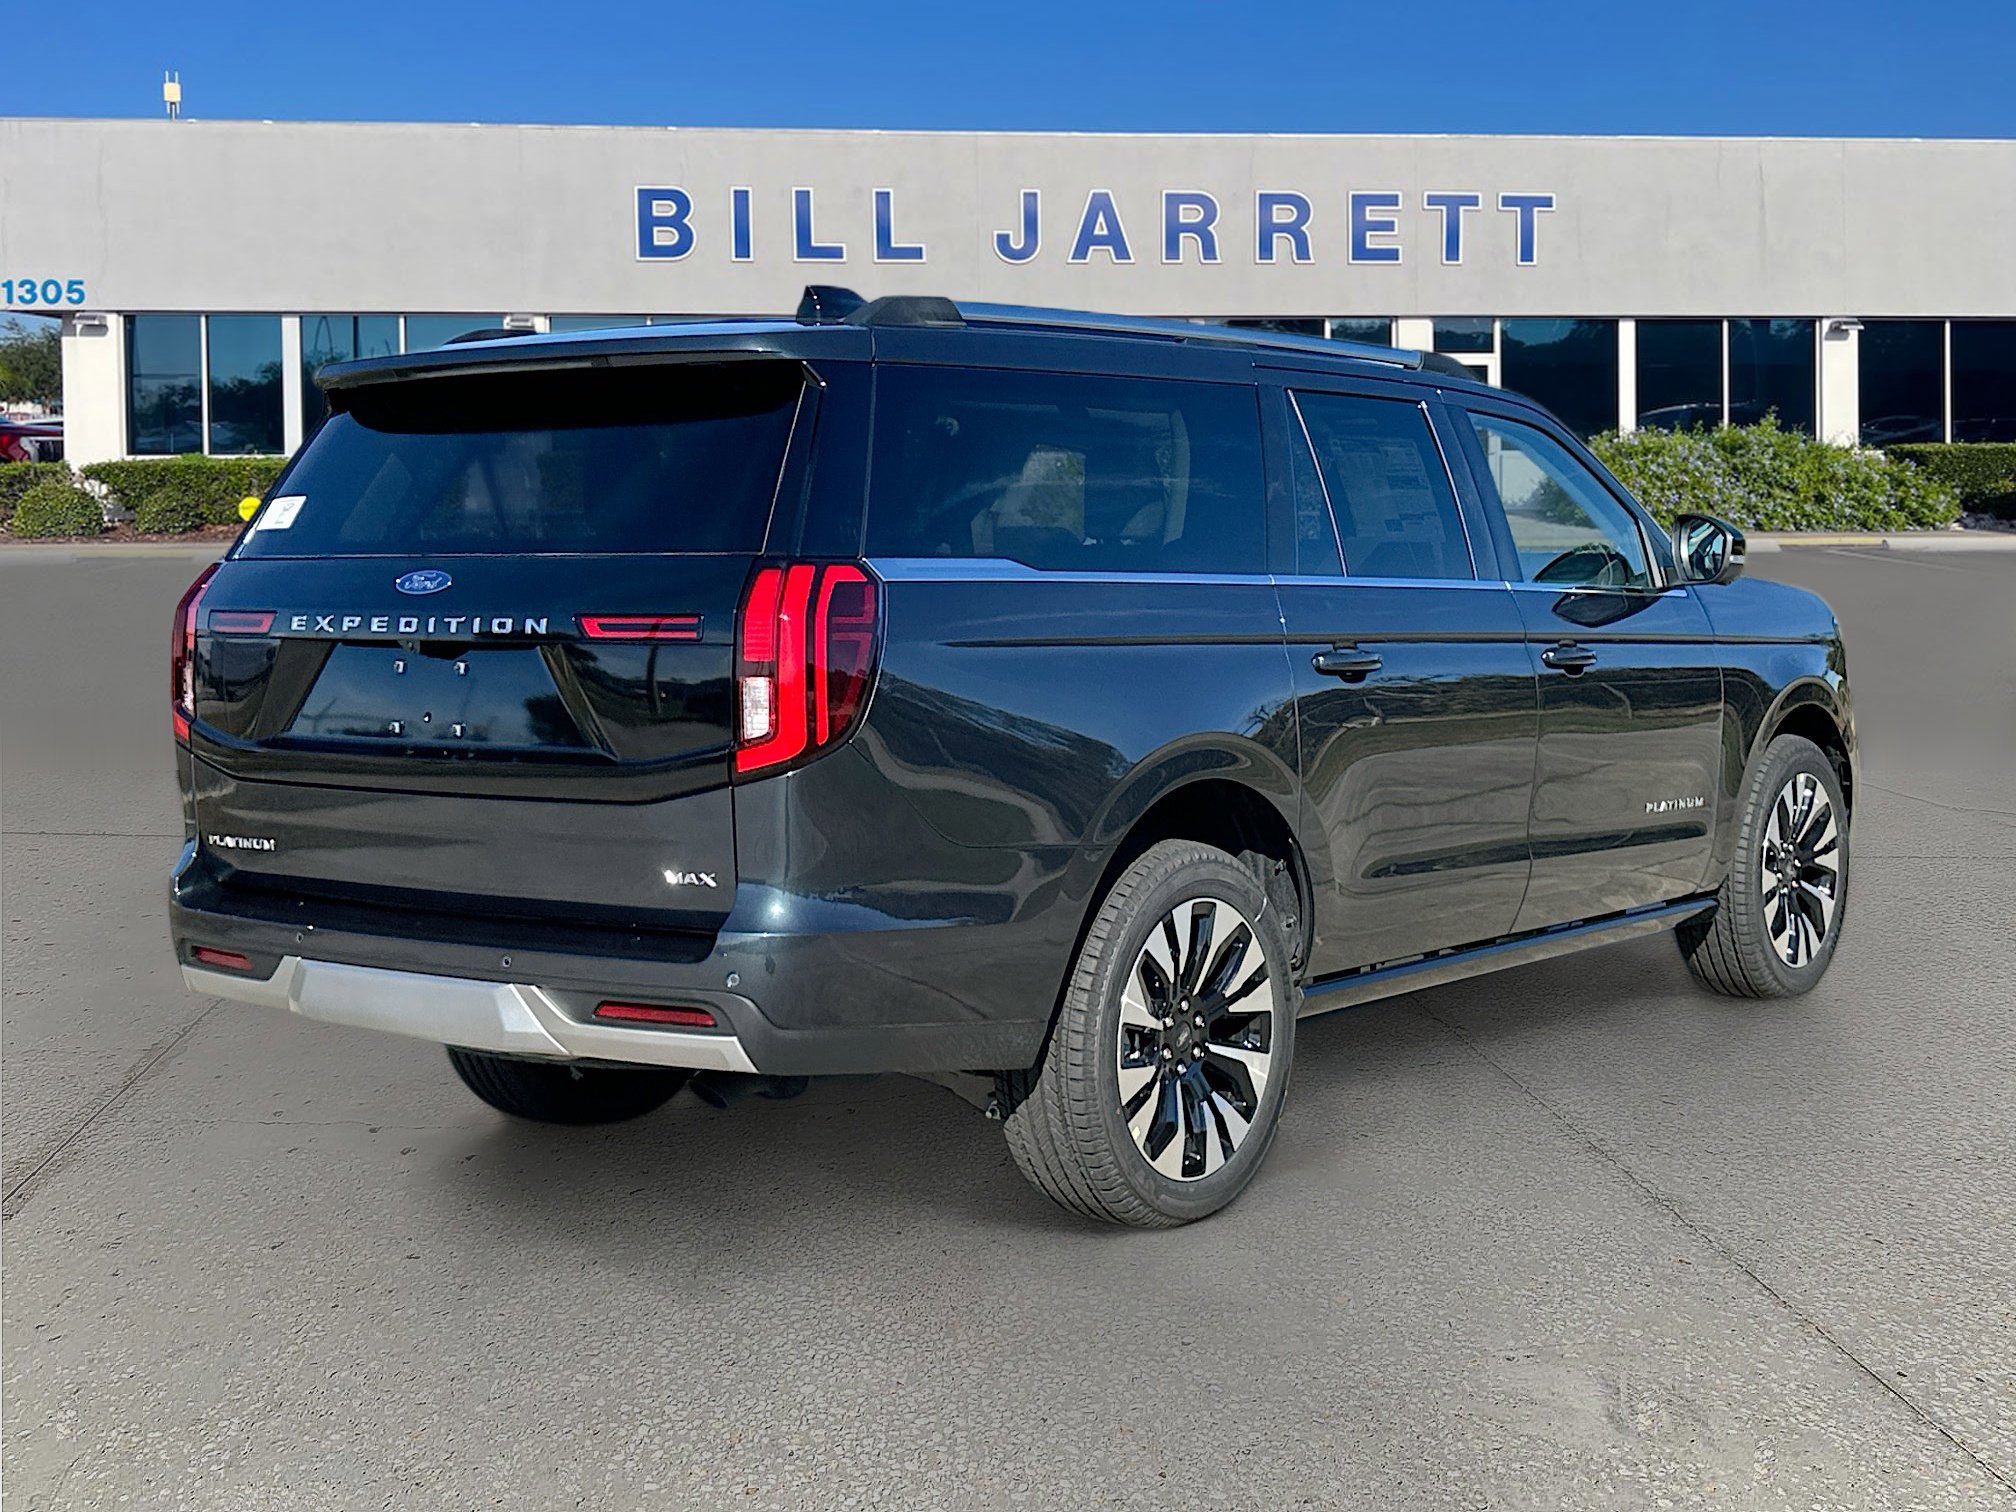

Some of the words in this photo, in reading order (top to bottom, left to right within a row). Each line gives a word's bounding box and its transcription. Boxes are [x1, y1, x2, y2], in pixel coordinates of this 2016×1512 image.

[634, 184, 927, 264] BILL
[991, 187, 1556, 267] JARRETT
[1, 278, 86, 305] 1305
[290, 614, 550, 636] EXPEDITION
[1645, 796, 1704, 814] PLATINUM
[207, 834, 275, 851] PLATINUM
[663, 869, 717, 888] MAX
